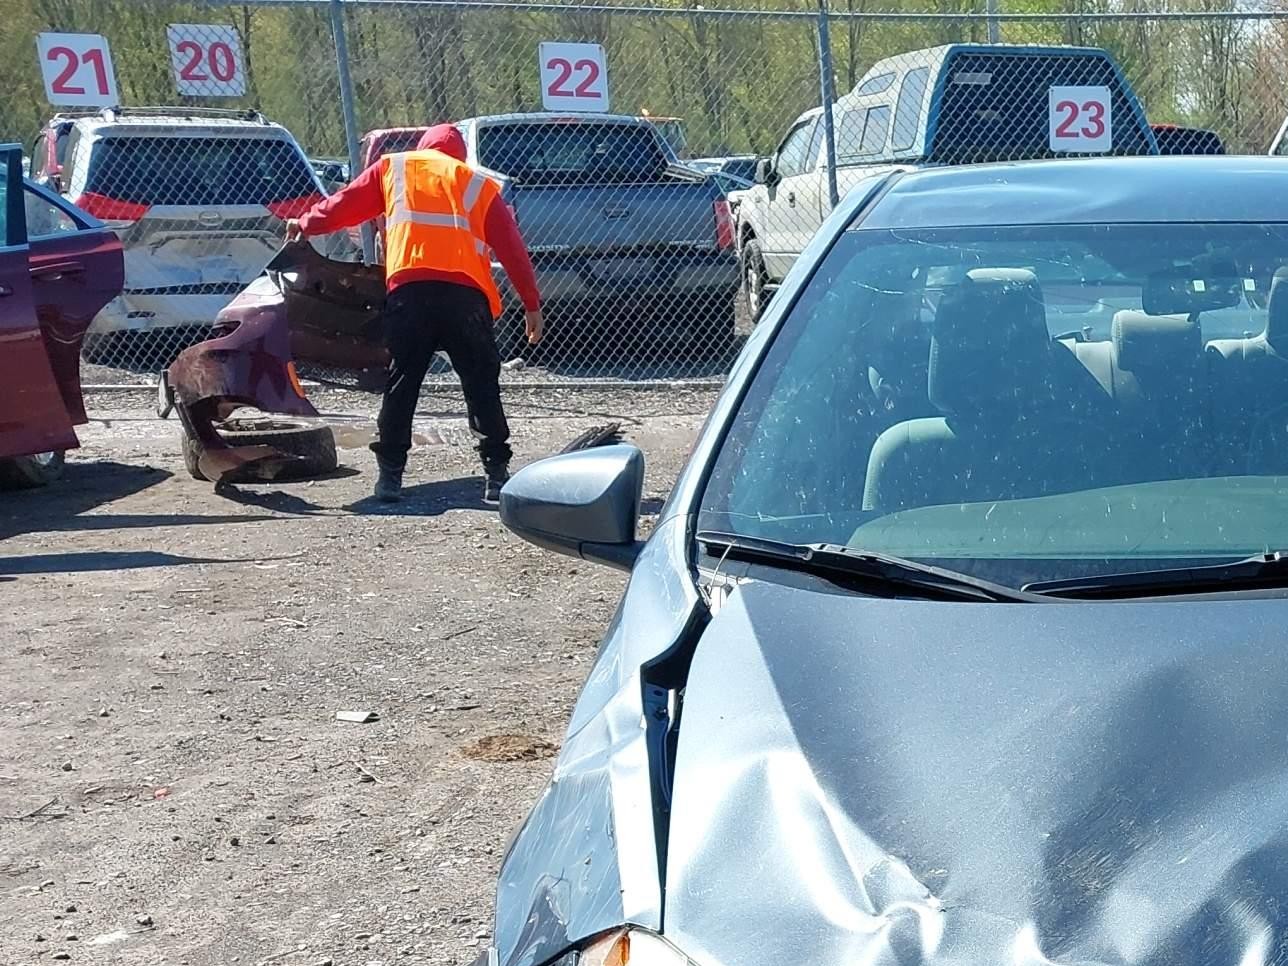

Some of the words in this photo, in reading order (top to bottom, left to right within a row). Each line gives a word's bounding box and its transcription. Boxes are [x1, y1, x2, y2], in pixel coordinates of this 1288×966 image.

[47, 47, 110, 96] 21
[176, 40, 236, 82] 20
[546, 58, 602, 98] 22
[1055, 100, 1105, 139] 23
